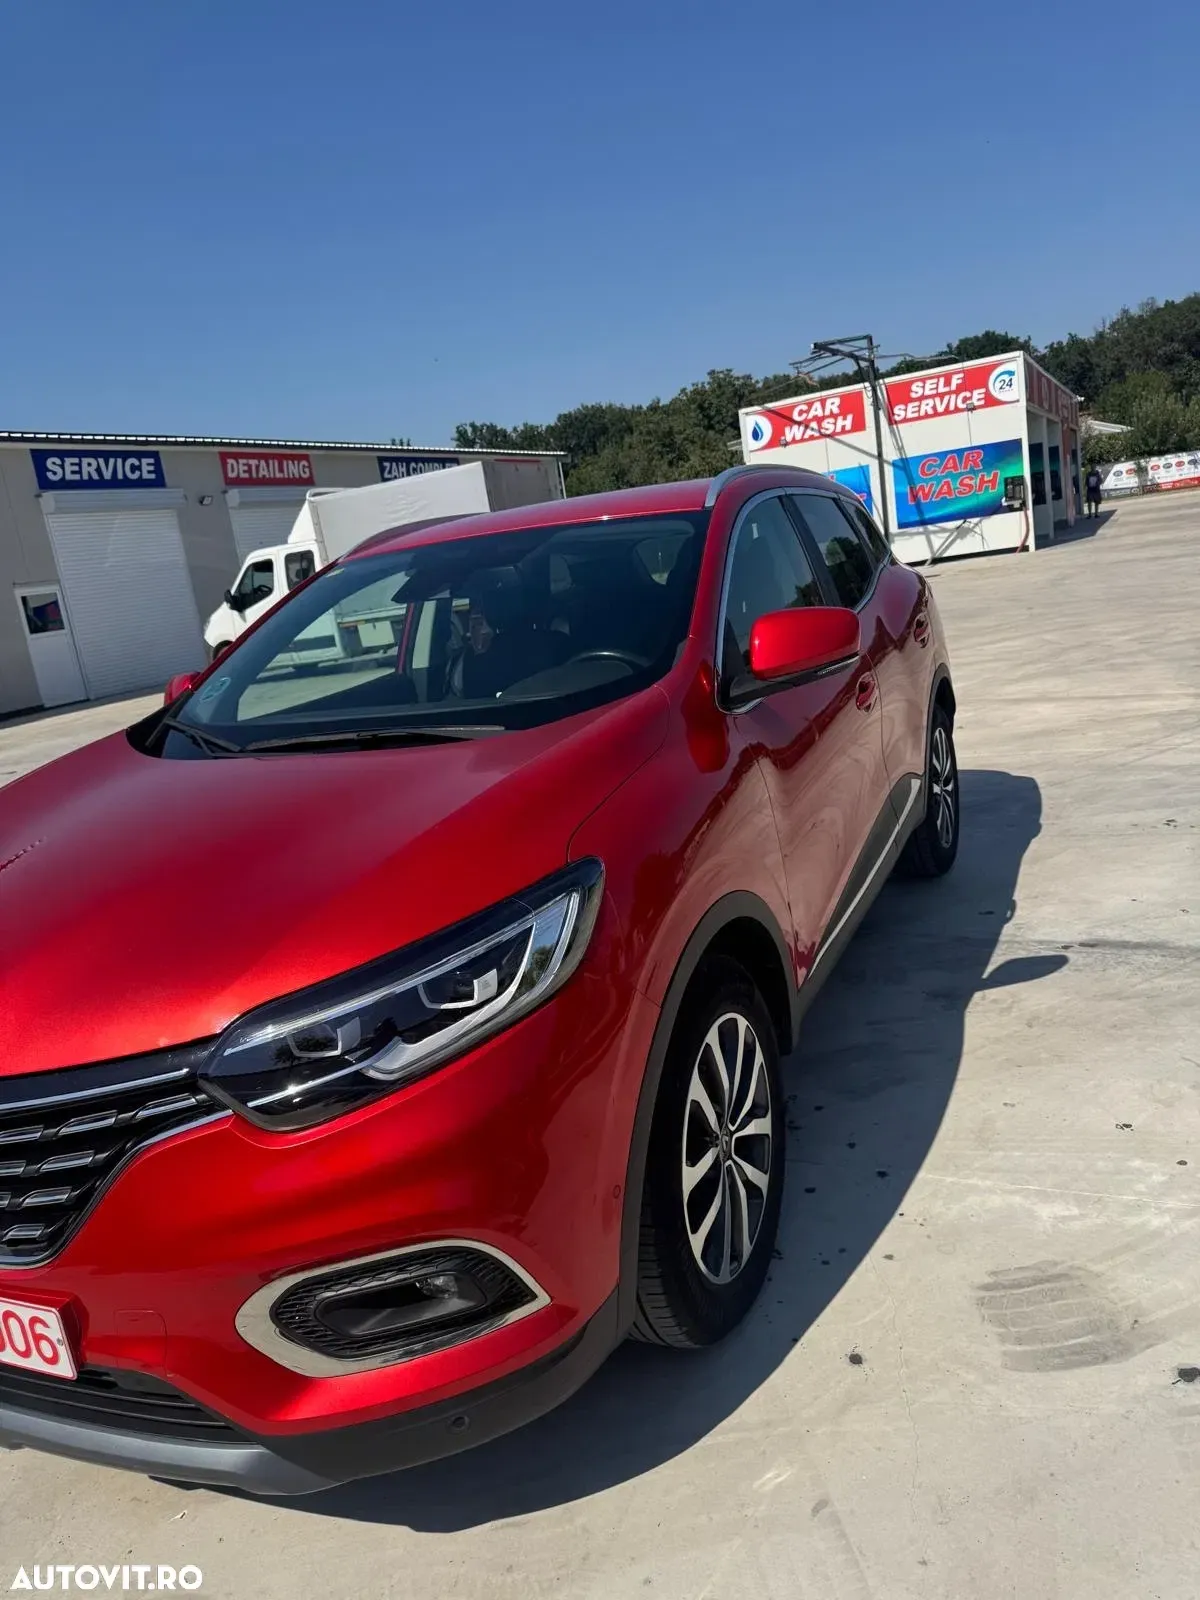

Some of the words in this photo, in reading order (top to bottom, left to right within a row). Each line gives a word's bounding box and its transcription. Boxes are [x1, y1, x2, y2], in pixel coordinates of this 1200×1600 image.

[910, 373, 964, 398] SELF
[999, 377, 1013, 390] 24
[792, 397, 840, 421] CAR
[893, 388, 986, 421] SERVICE
[784, 414, 853, 442] WASH
[46, 457, 156, 481] SERVICE
[226, 459, 310, 479] DETAILING
[383, 462, 406, 478] ZAH
[410, 463, 457, 475] COMP
[919, 449, 983, 478] CAR
[908, 470, 999, 505] WASH
[0, 1309, 60, 1366] 06
